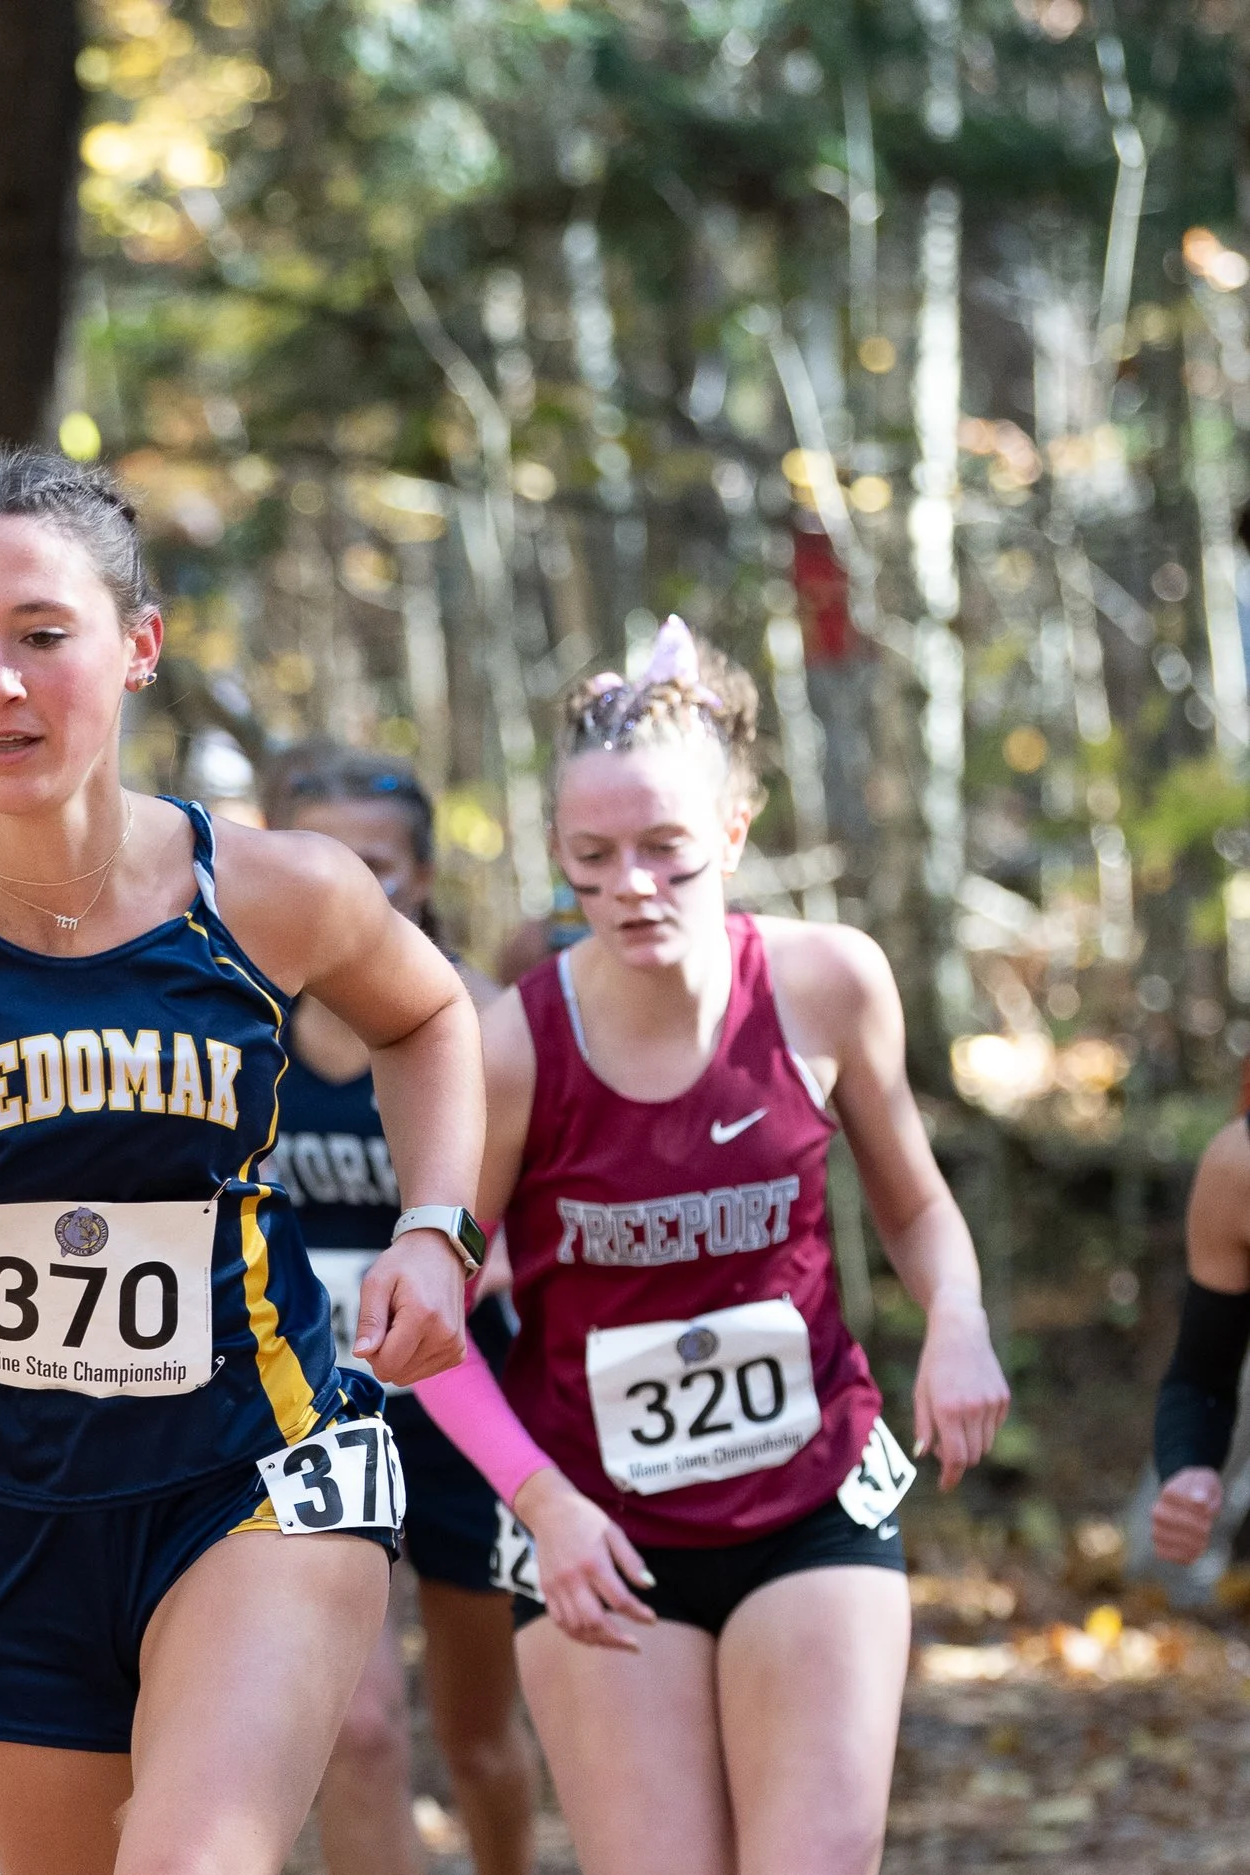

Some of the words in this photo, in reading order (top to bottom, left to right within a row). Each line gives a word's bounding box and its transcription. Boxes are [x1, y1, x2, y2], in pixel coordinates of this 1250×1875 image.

[556, 1173, 800, 1268] FREEPORT
[26, 1356, 68, 1381] State
[73, 1360, 187, 1388] Championship
[625, 1356, 786, 1447] 320
